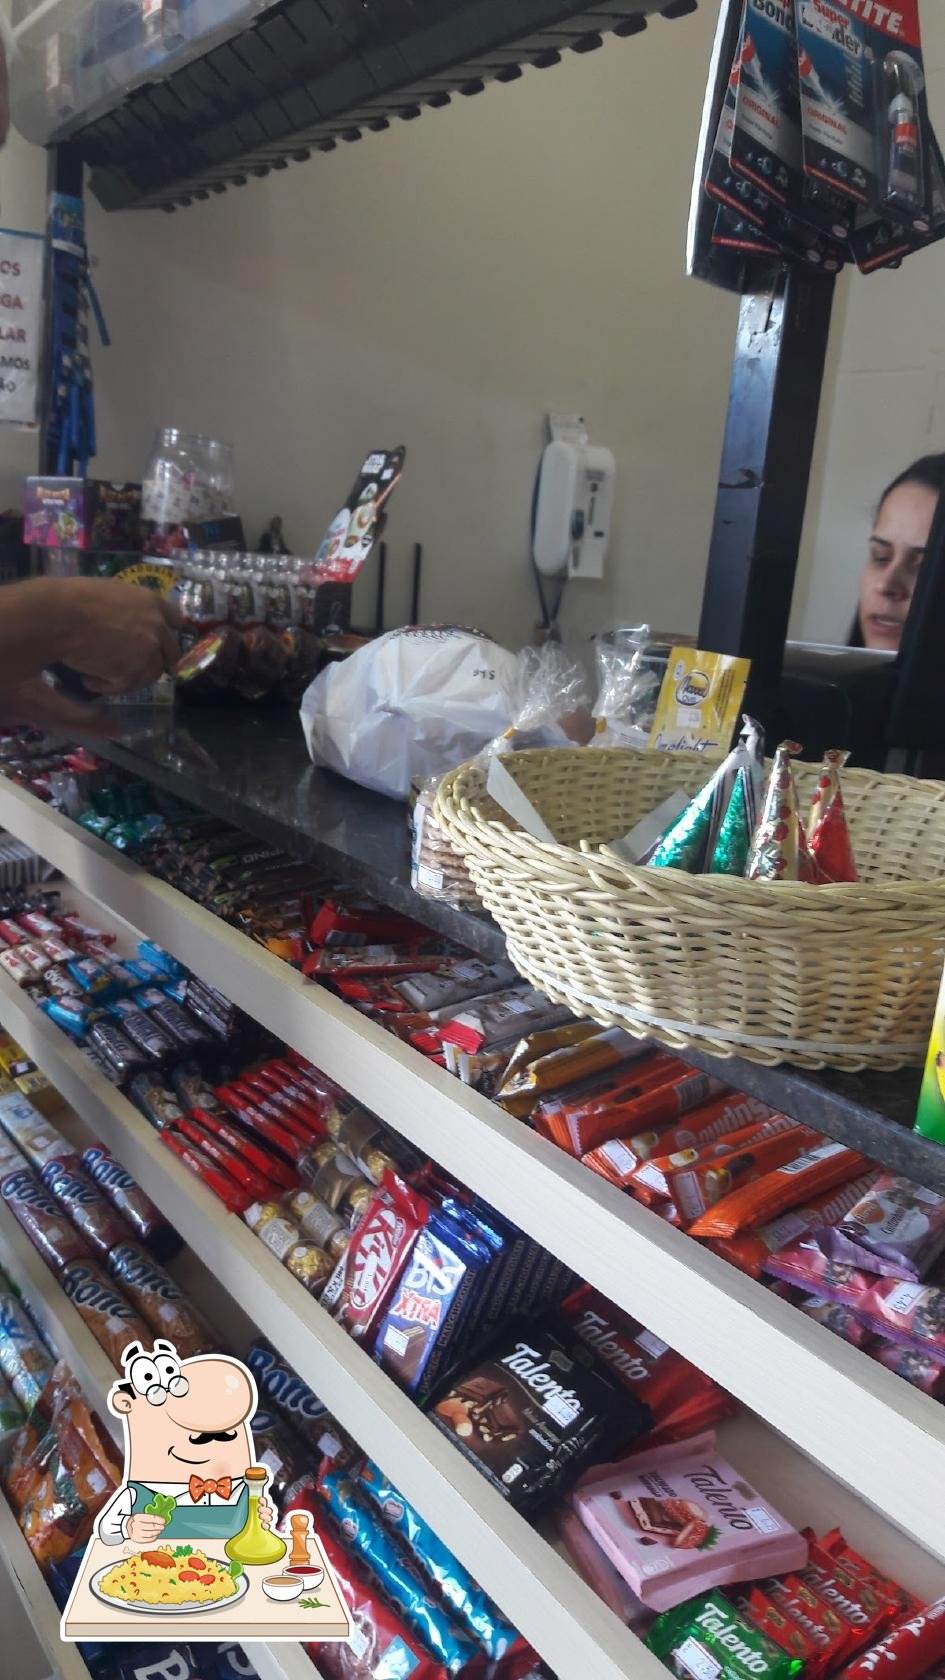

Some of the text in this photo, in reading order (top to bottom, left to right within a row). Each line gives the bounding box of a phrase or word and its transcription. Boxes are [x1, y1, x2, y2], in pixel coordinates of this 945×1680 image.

[573, 1310, 650, 1382] Talento
[683, 1464, 753, 1530] Talento
[695, 1602, 769, 1673] Talento
